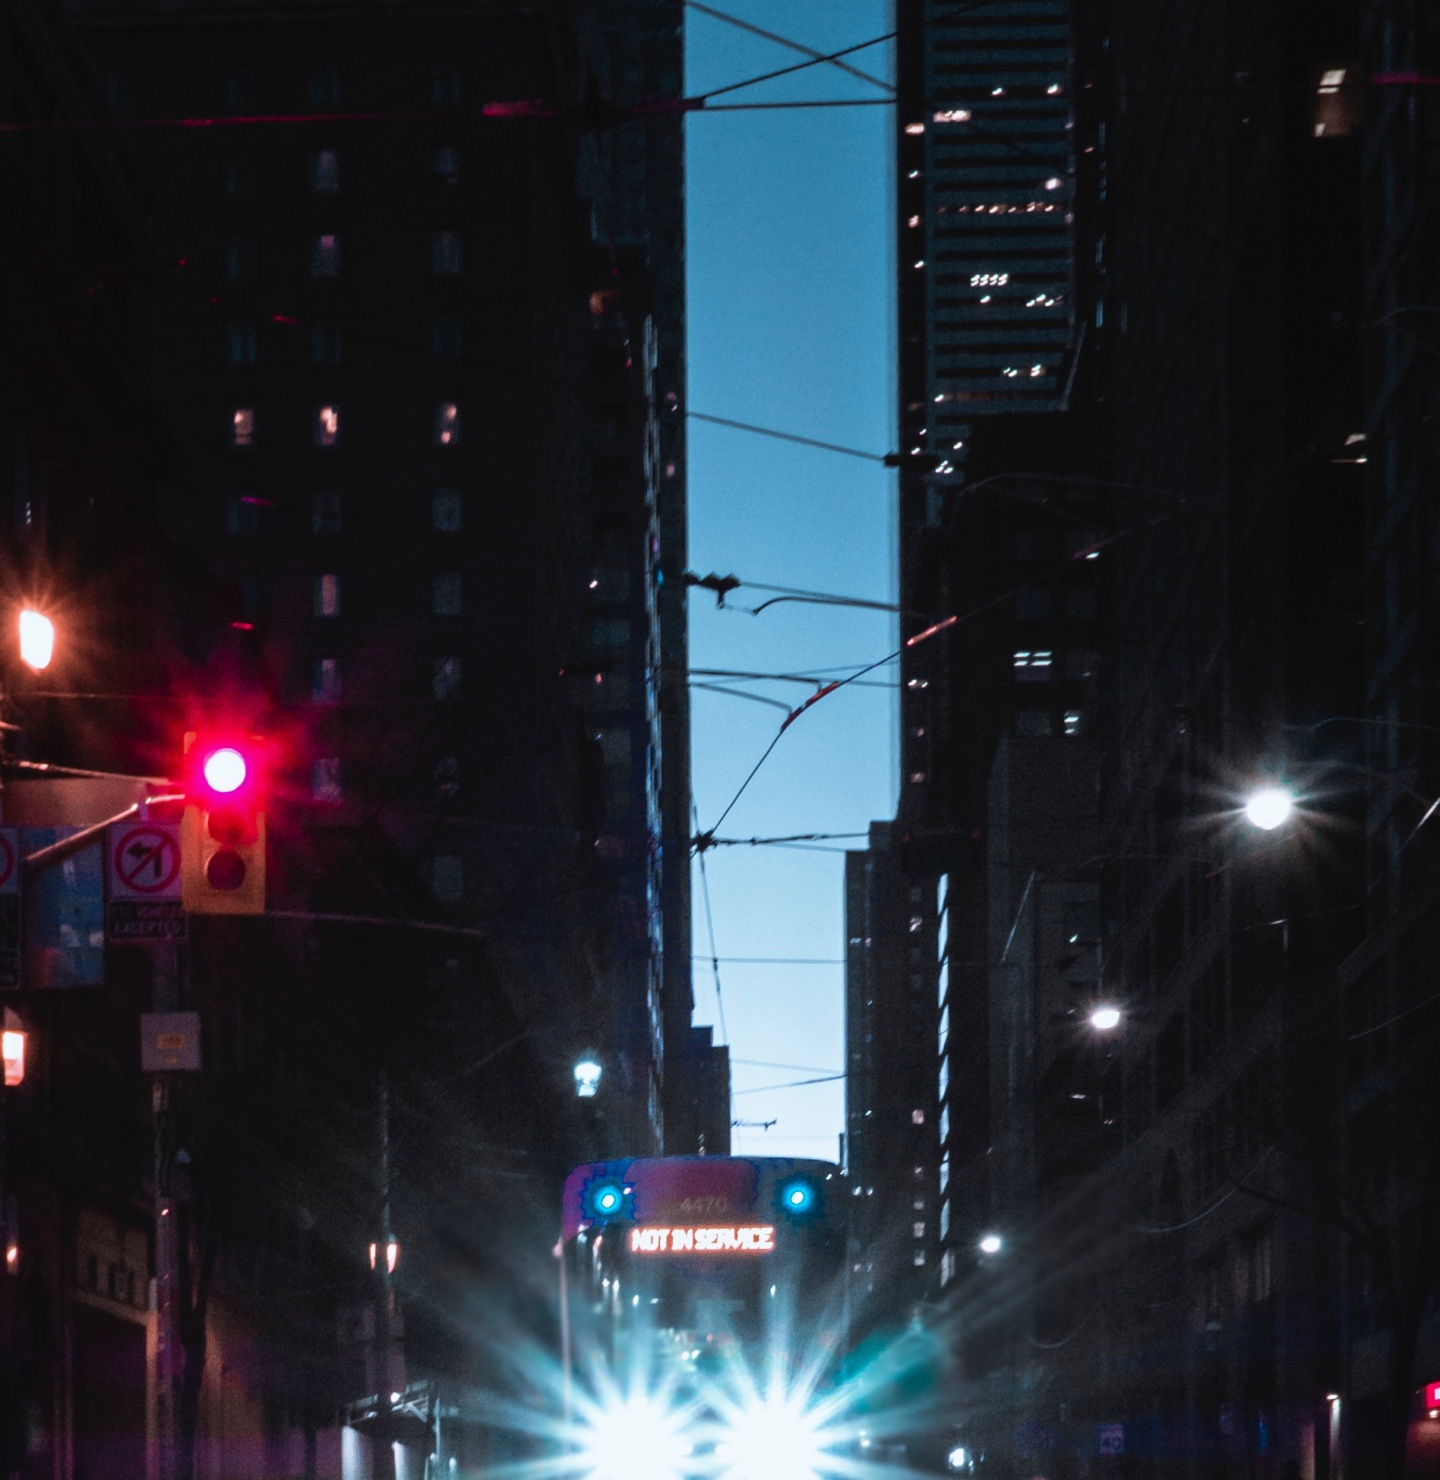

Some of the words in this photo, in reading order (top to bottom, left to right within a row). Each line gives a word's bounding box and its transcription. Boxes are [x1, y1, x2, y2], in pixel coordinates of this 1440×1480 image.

[680, 1195, 728, 1214] 4470
[631, 1228, 669, 1251] NOT
[671, 1228, 694, 1251] IN
[694, 1226, 774, 1250] SERVICE
